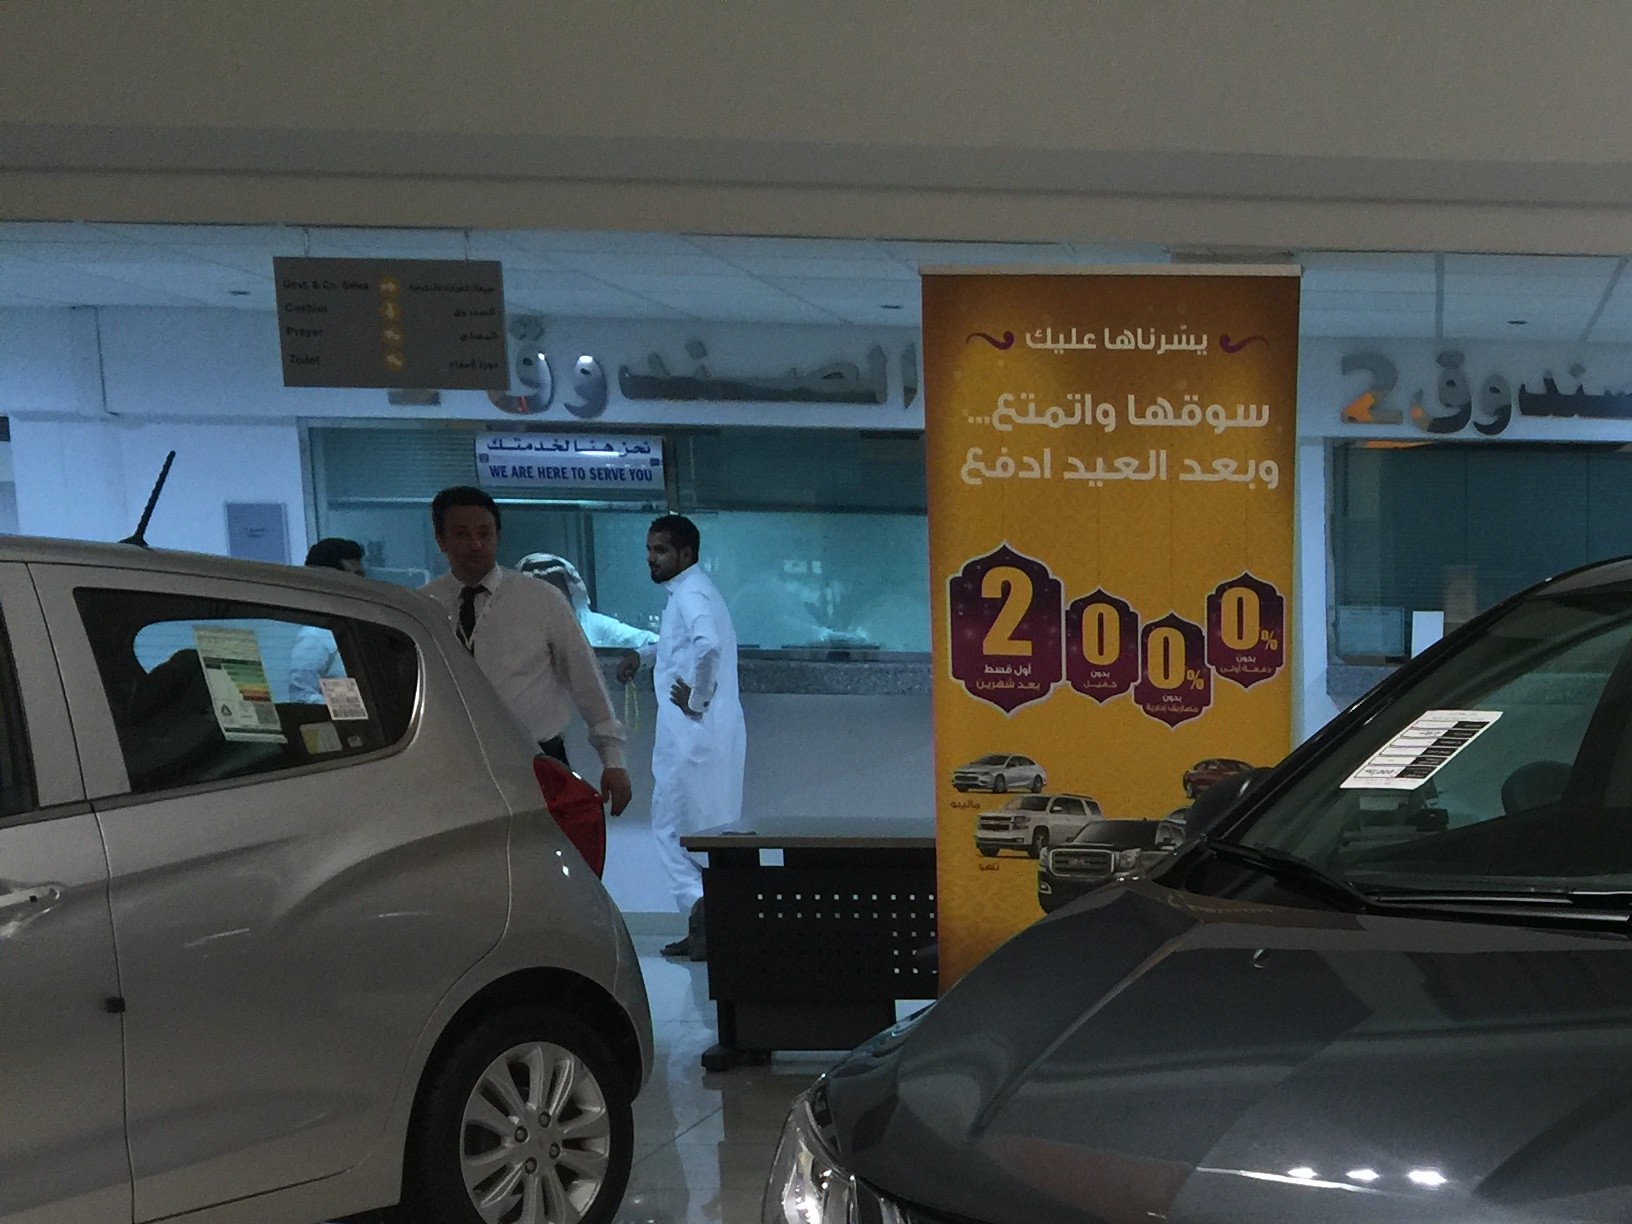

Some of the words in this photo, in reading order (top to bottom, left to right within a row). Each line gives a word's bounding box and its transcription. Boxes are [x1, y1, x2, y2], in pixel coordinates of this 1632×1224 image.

[287, 326, 323, 338] Prayer
[1025, 327, 1097, 355] عليك
[289, 353, 320, 365] Toilet
[1341, 350, 1403, 424] 2
[1127, 394, 1270, 434] سوقها
[487, 438, 570, 452] لخدمتك
[574, 440, 614, 452] هنا
[960, 447, 1051, 485] ادفع
[1063, 449, 1167, 487] العيد
[1179, 454, 1279, 489] وبعد
[489, 465, 507, 478] WE
[511, 465, 534, 479] ARE
[537, 466, 569, 480] HERE
[571, 466, 586, 480] TO
[589, 467, 626, 481] SERVE
[629, 467, 652, 482] YOU
[981, 566, 1033, 656] 2
[1082, 603, 1120, 665] 0
[1236, 654, 1256, 662] بدون
[984, 664, 1012, 674] قسط
[1014, 663, 1032, 677] أول
[1090, 670, 1110, 678] بدون
[976, 678, 1015, 690] شهرين
[1017, 680, 1040, 691] بعد
[1162, 694, 1182, 702] بدون
